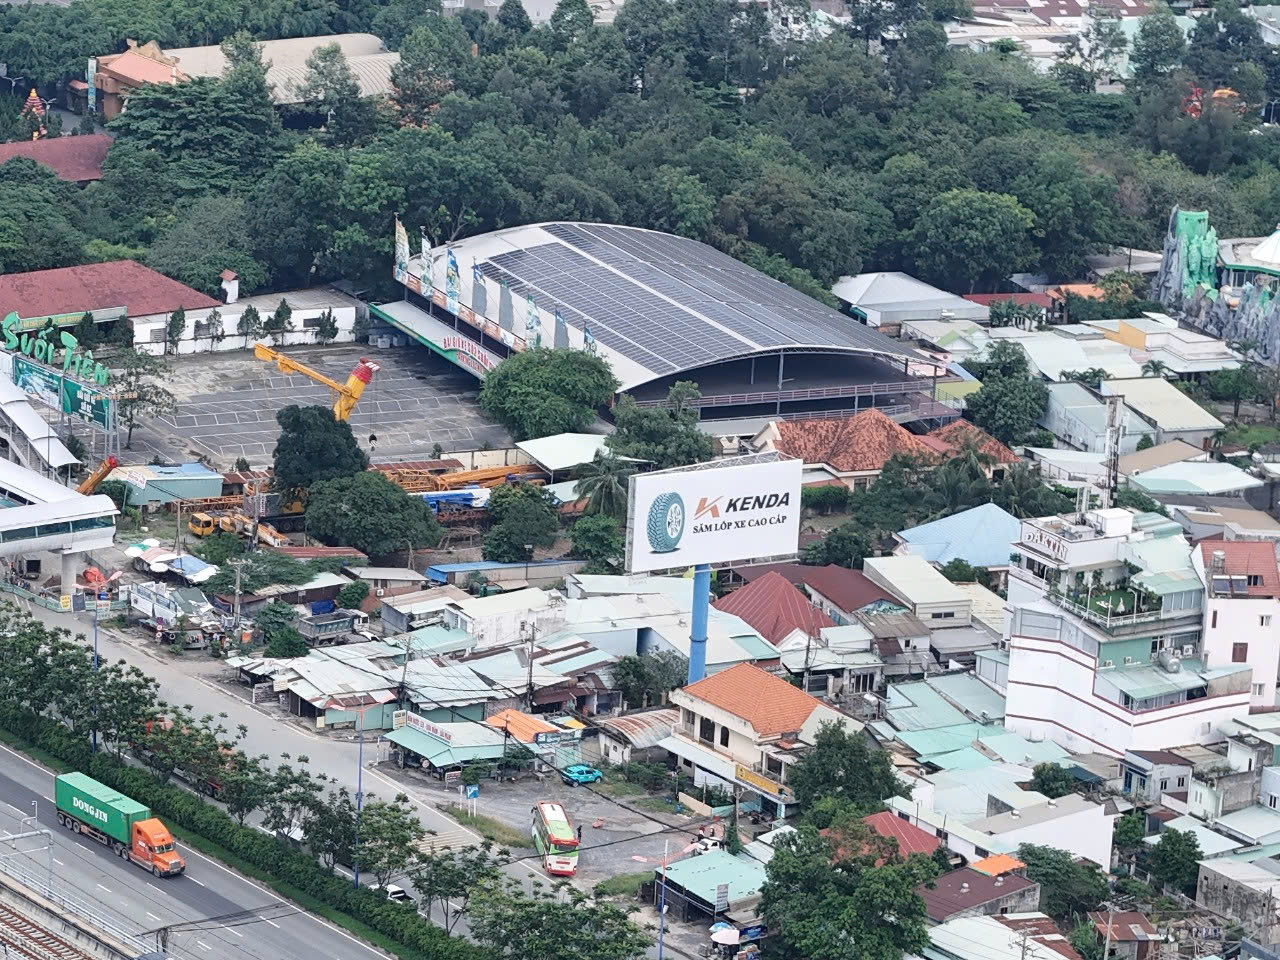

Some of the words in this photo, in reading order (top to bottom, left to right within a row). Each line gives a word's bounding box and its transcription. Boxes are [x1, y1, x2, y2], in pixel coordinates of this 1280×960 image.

[725, 492, 790, 513] KENDA
[693, 521, 713, 534] SĂM
[714, 520, 733, 532] LỐP
[734, 519, 747, 530] XE
[748, 517, 767, 527] CAO
[769, 514, 788, 525] CẤP
